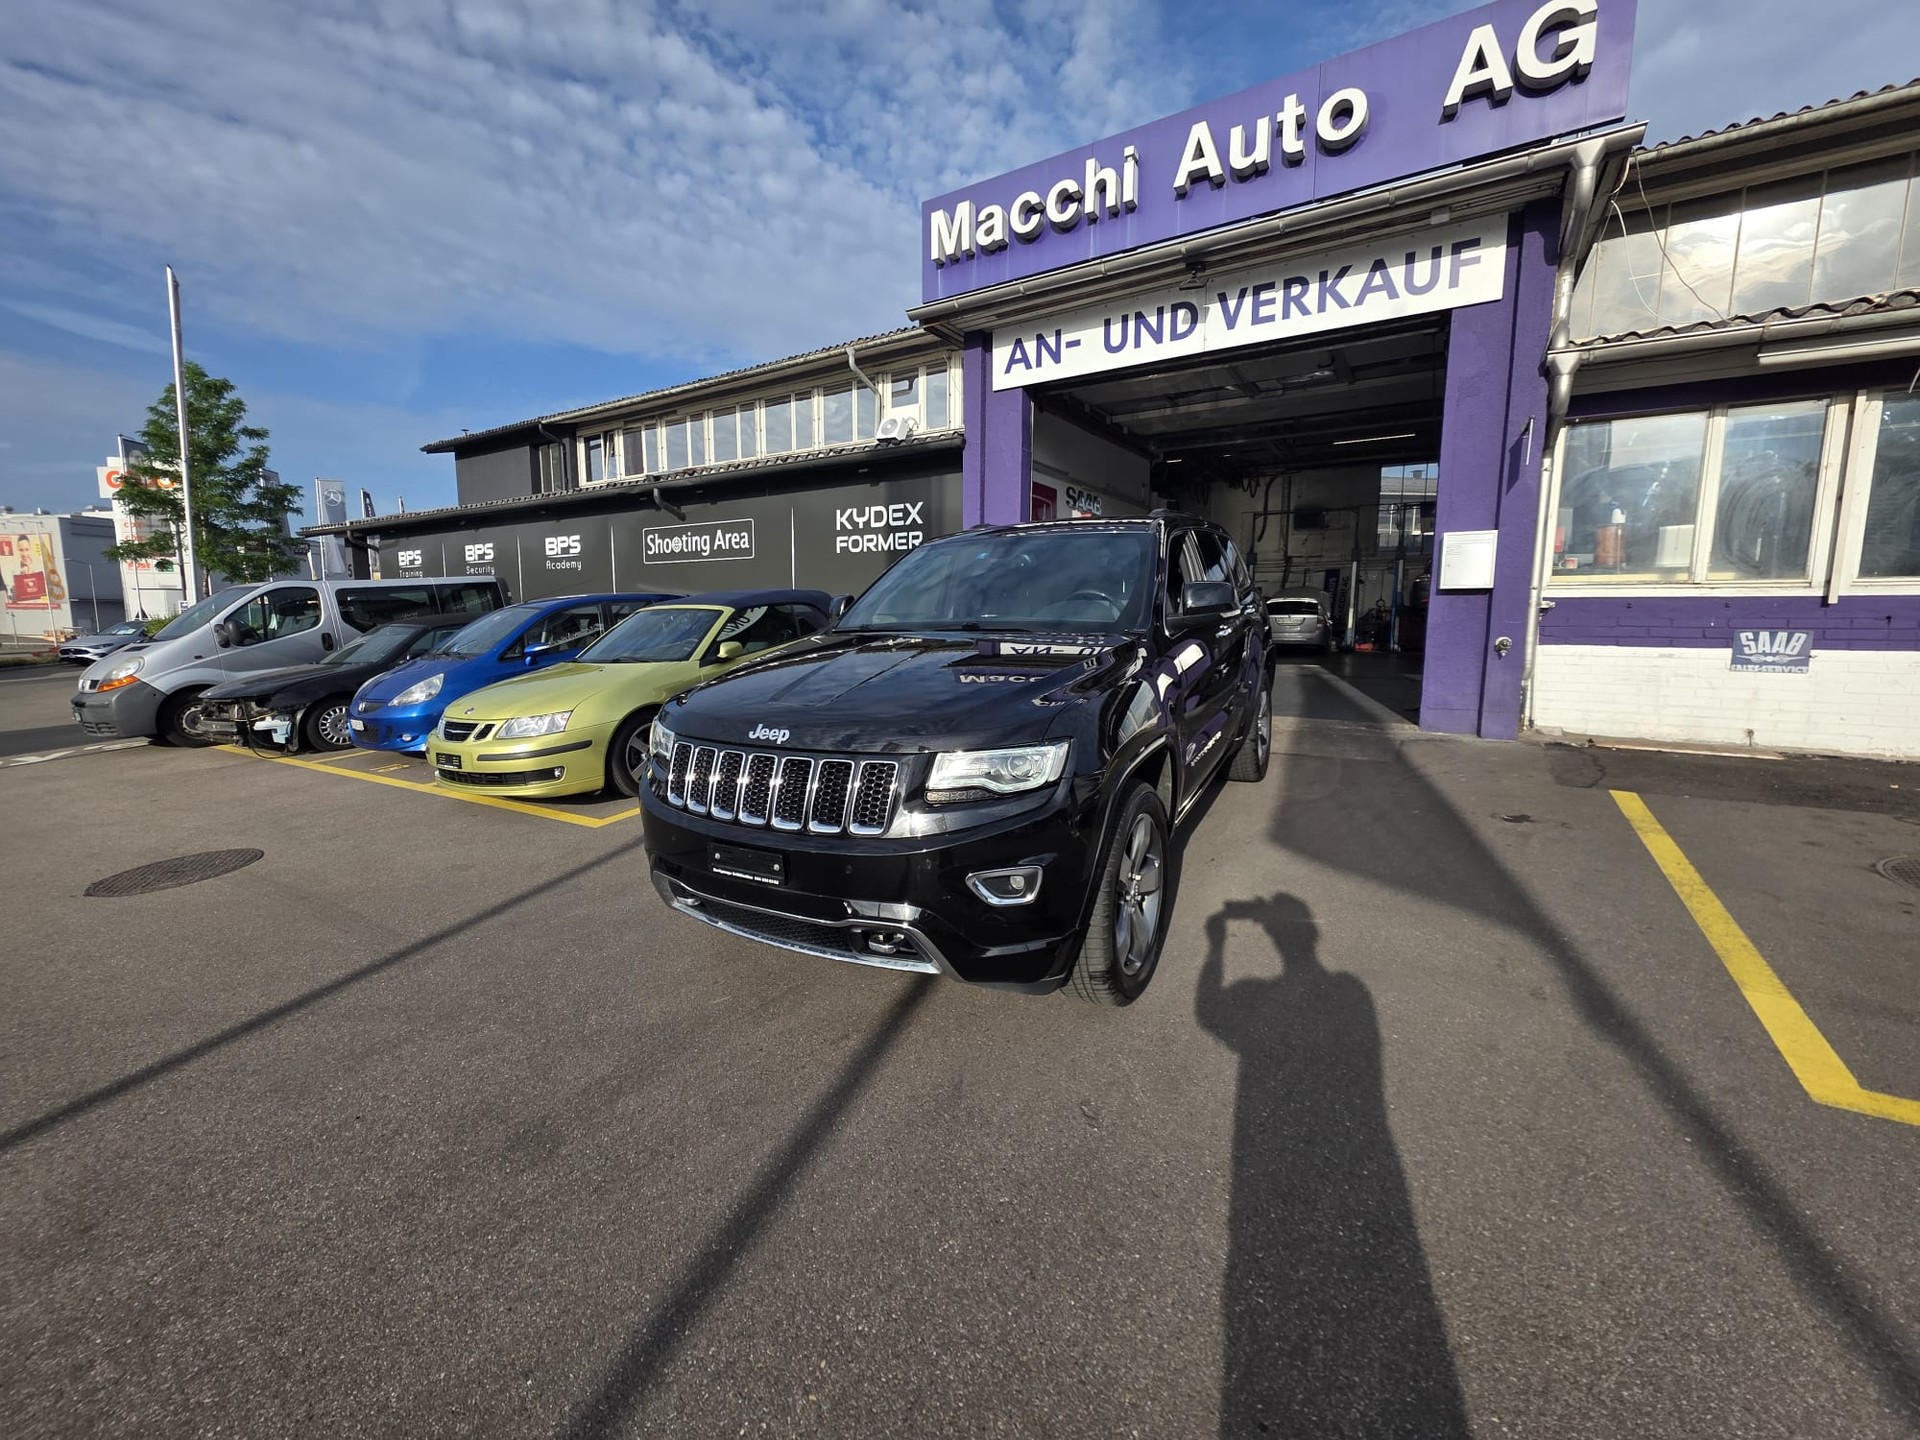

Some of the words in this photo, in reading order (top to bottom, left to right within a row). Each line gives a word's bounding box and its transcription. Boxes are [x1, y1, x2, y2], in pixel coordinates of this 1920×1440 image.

[930, 145, 1140, 265] Macchi
[1173, 87, 1369, 194] Auto
[1443, 0, 1598, 114] AG
[1004, 328, 1081, 375] AN-
[1103, 300, 1199, 354] UND
[1217, 236, 1481, 331] VERKAUF
[836, 501, 924, 531] KYDEX
[545, 534, 581, 555] BPS
[713, 529, 750, 550] Area
[836, 531, 923, 554] FORMER
[398, 550, 422, 566] BPS
[464, 543, 494, 561] BPS
[465, 566, 495, 576] Security
[546, 560, 582, 571] Academy
[1740, 631, 1807, 655] SAAB
[748, 723, 790, 745] Jeep
